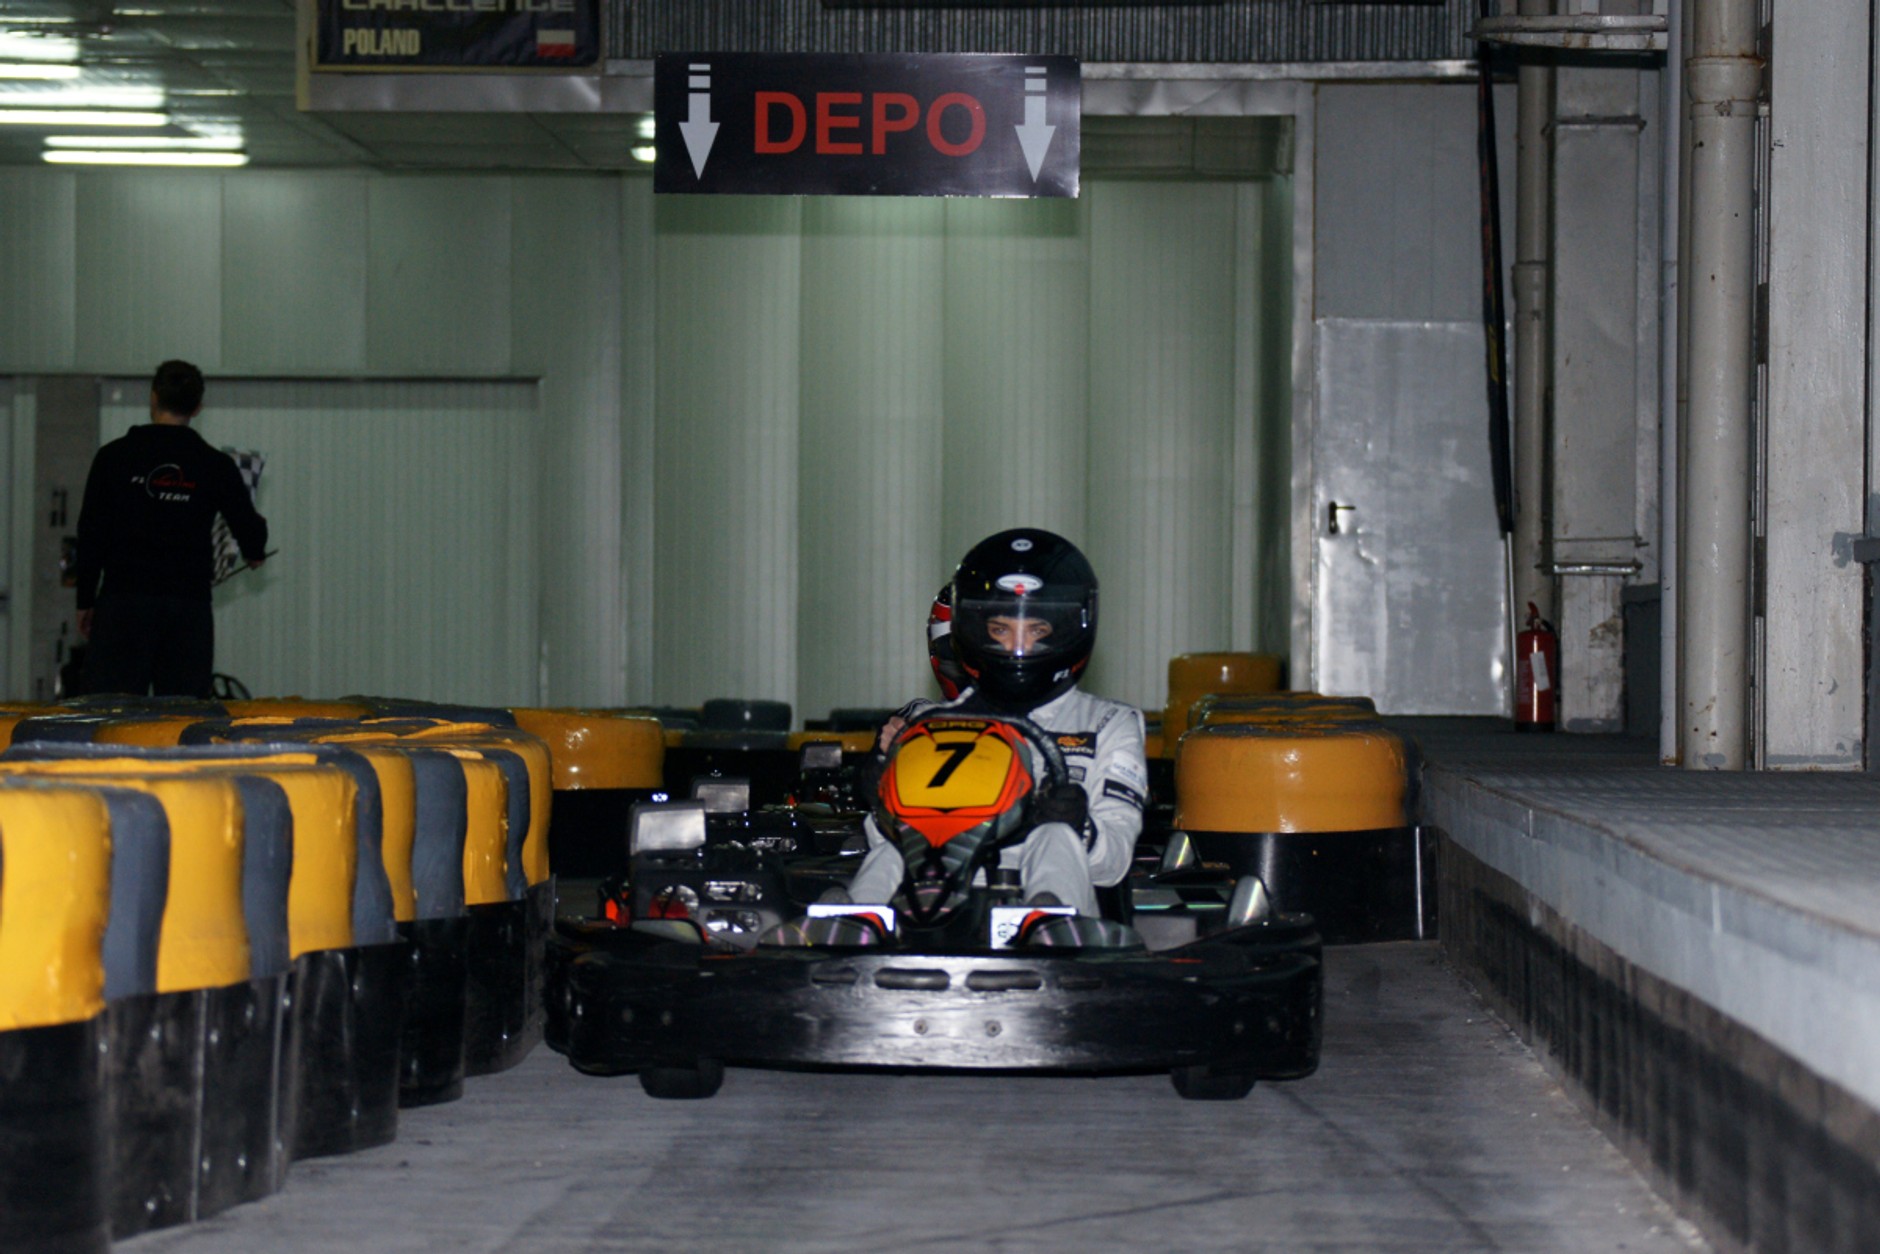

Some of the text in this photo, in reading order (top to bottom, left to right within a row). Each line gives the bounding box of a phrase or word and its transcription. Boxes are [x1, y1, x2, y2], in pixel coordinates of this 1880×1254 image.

[343, 28, 421, 55] POLAND
[754, 91, 987, 157] DEPO
[158, 492, 191, 502] TEAM
[926, 741, 977, 788] 7
